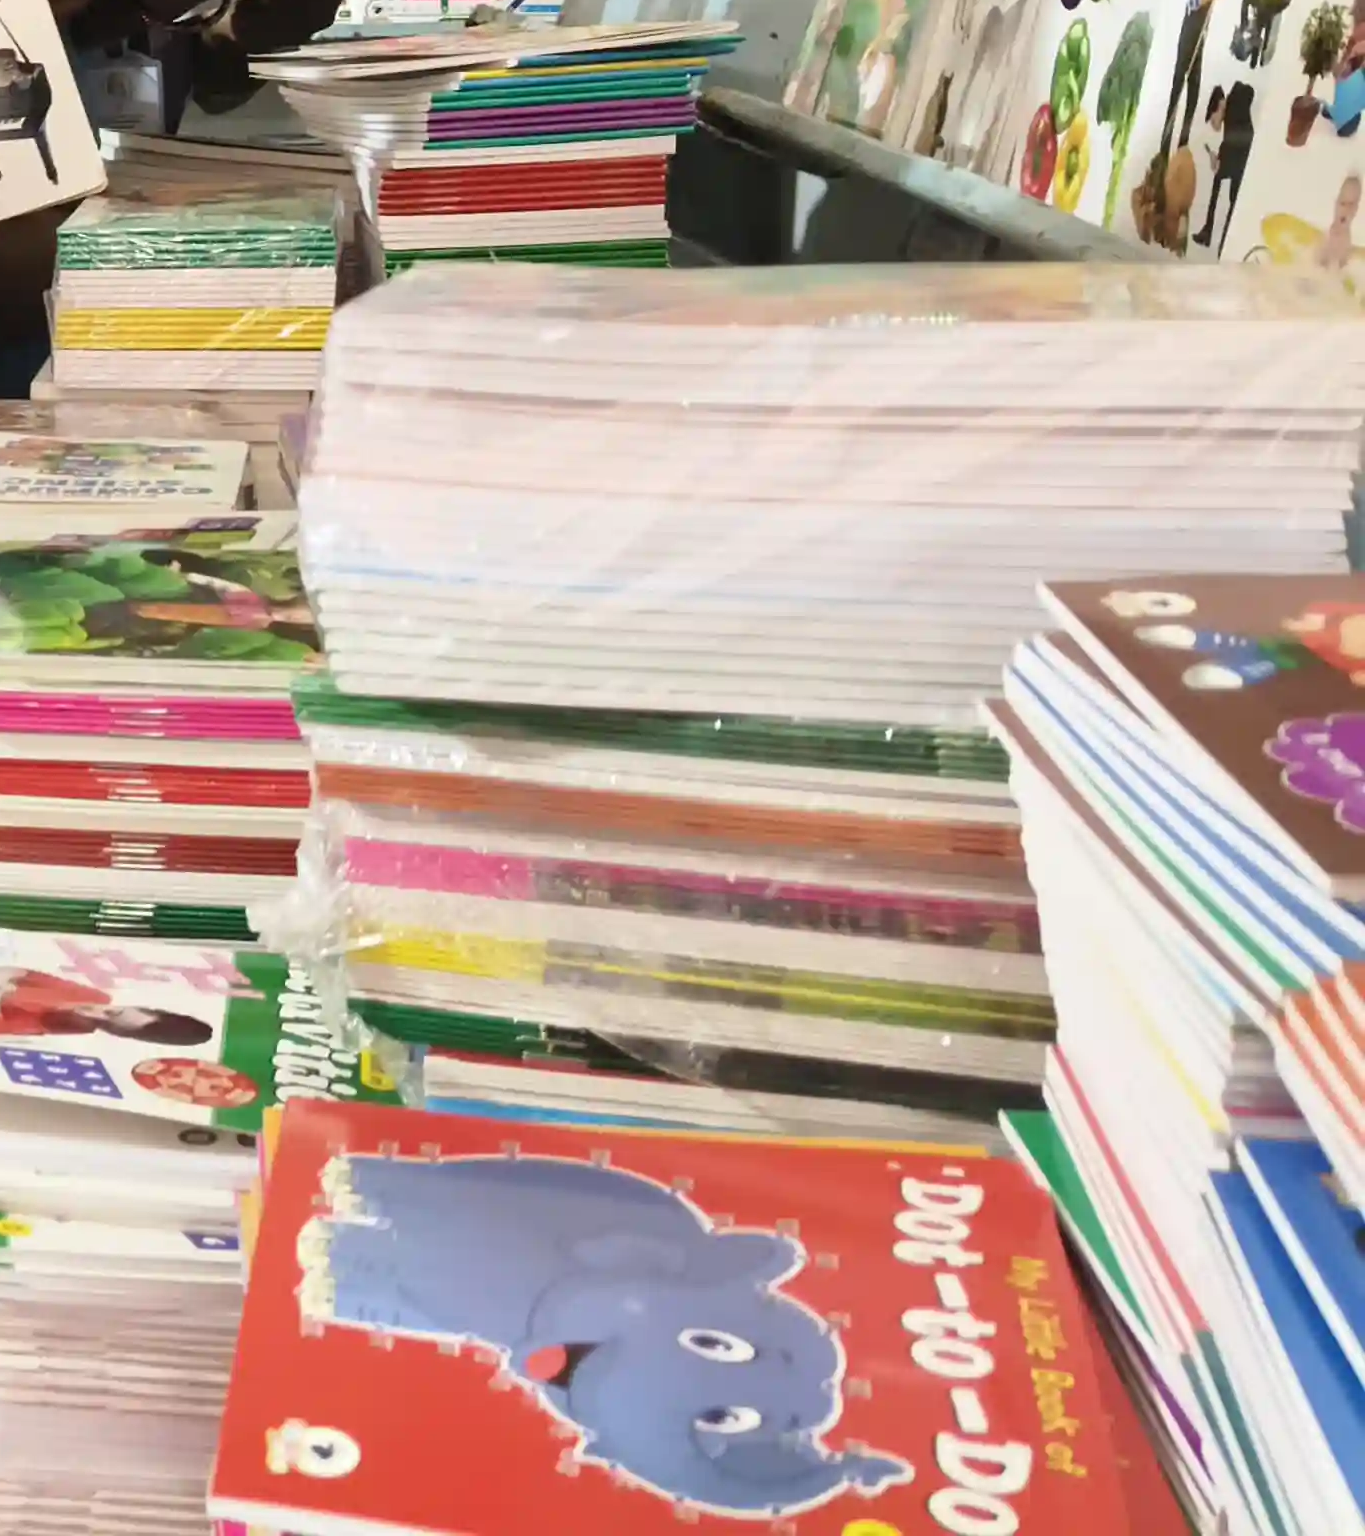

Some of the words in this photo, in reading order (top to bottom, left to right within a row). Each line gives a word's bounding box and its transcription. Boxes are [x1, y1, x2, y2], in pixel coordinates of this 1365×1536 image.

[1005, 1255, 1048, 1291] My
[1017, 1296, 1067, 1362] Little
[1029, 1367, 1082, 1437] Book
[1044, 1441, 1089, 1479] of
